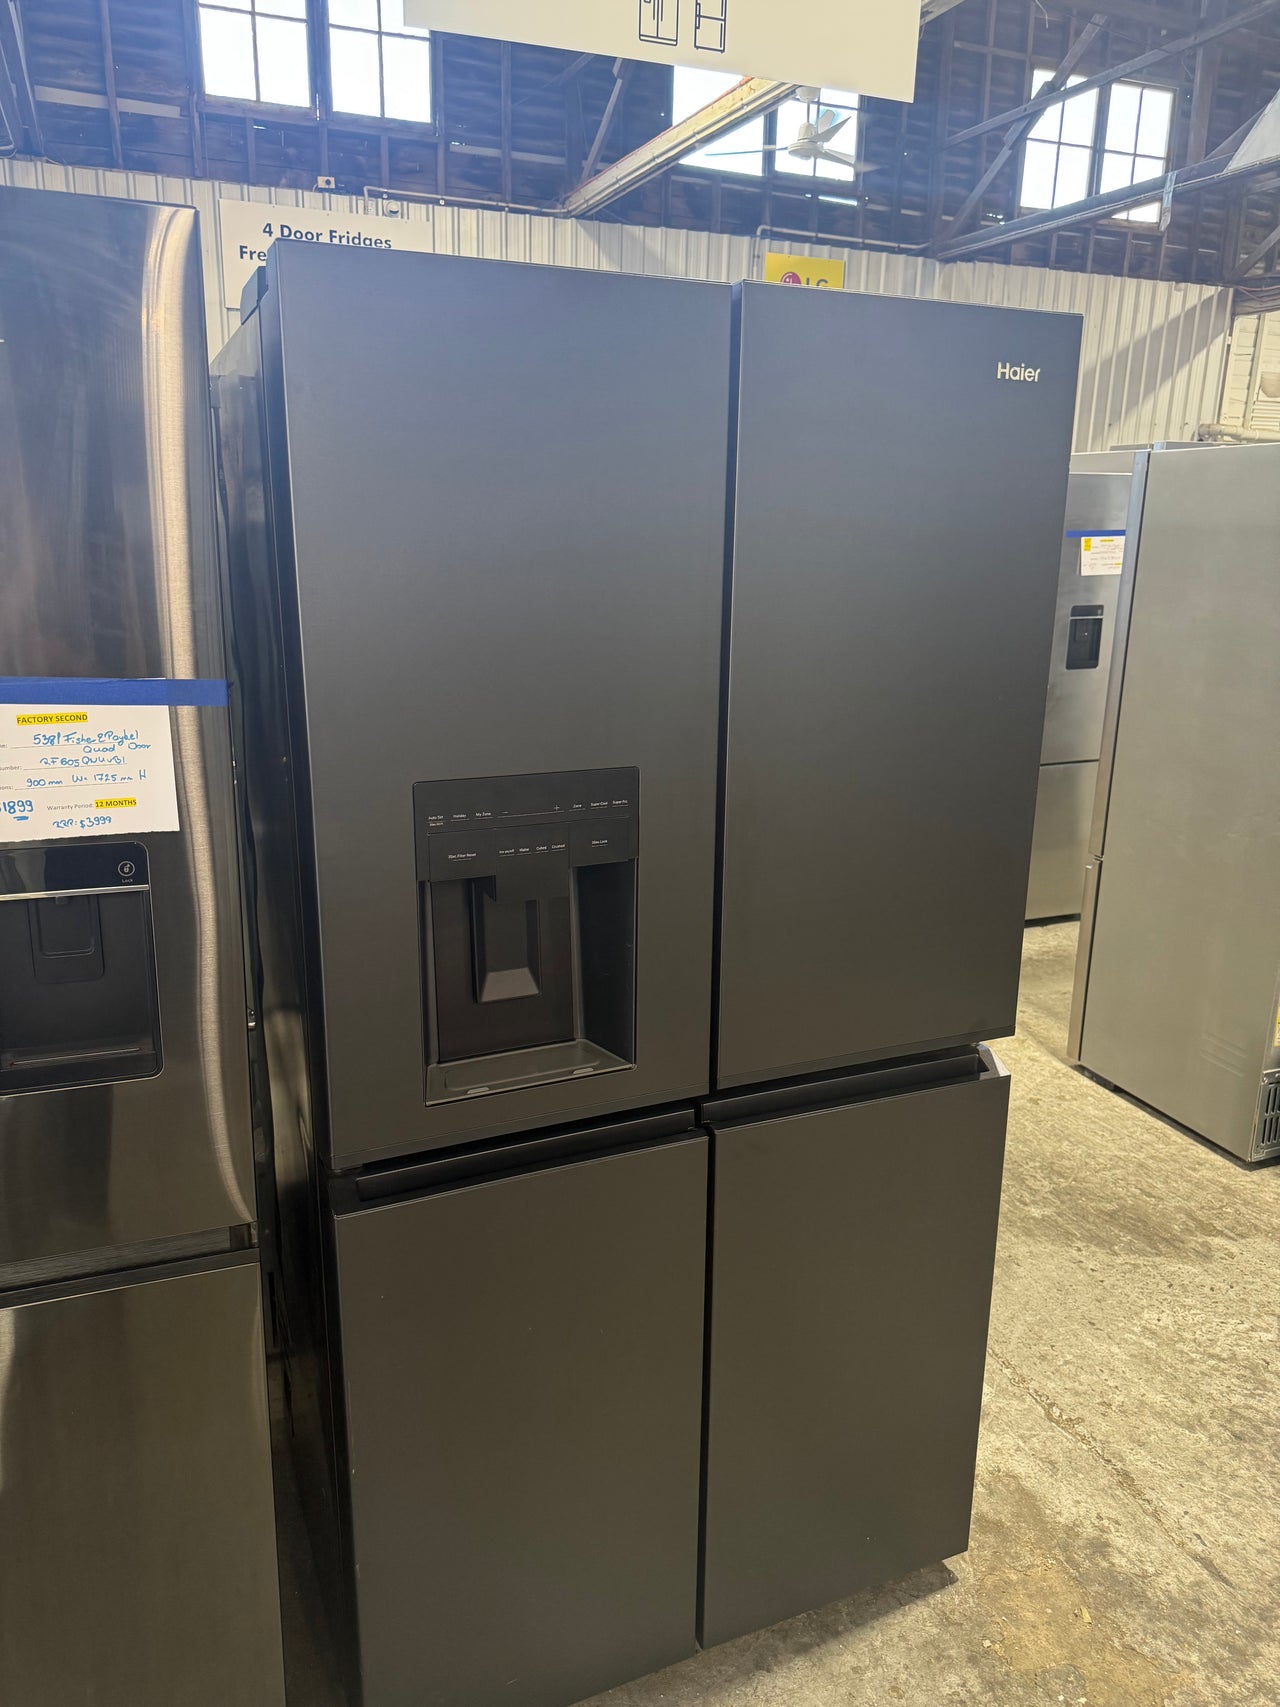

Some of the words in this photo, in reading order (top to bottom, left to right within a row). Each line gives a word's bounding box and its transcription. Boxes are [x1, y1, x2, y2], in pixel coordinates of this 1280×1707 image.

[262, 222, 273, 238] 4
[280, 224, 323, 242] Door
[997, 361, 1041, 383] Haier
[17, 715, 53, 725] FACTORY
[55, 714, 88, 723] SECOND
[26, 778, 46, 787] 900
[93, 773, 117, 782] 1725
[139, 769, 146, 780] H
[46, 803, 73, 811] Warranty
[105, 799, 137, 807] MONTHS
[79, 816, 112, 829] $3999
